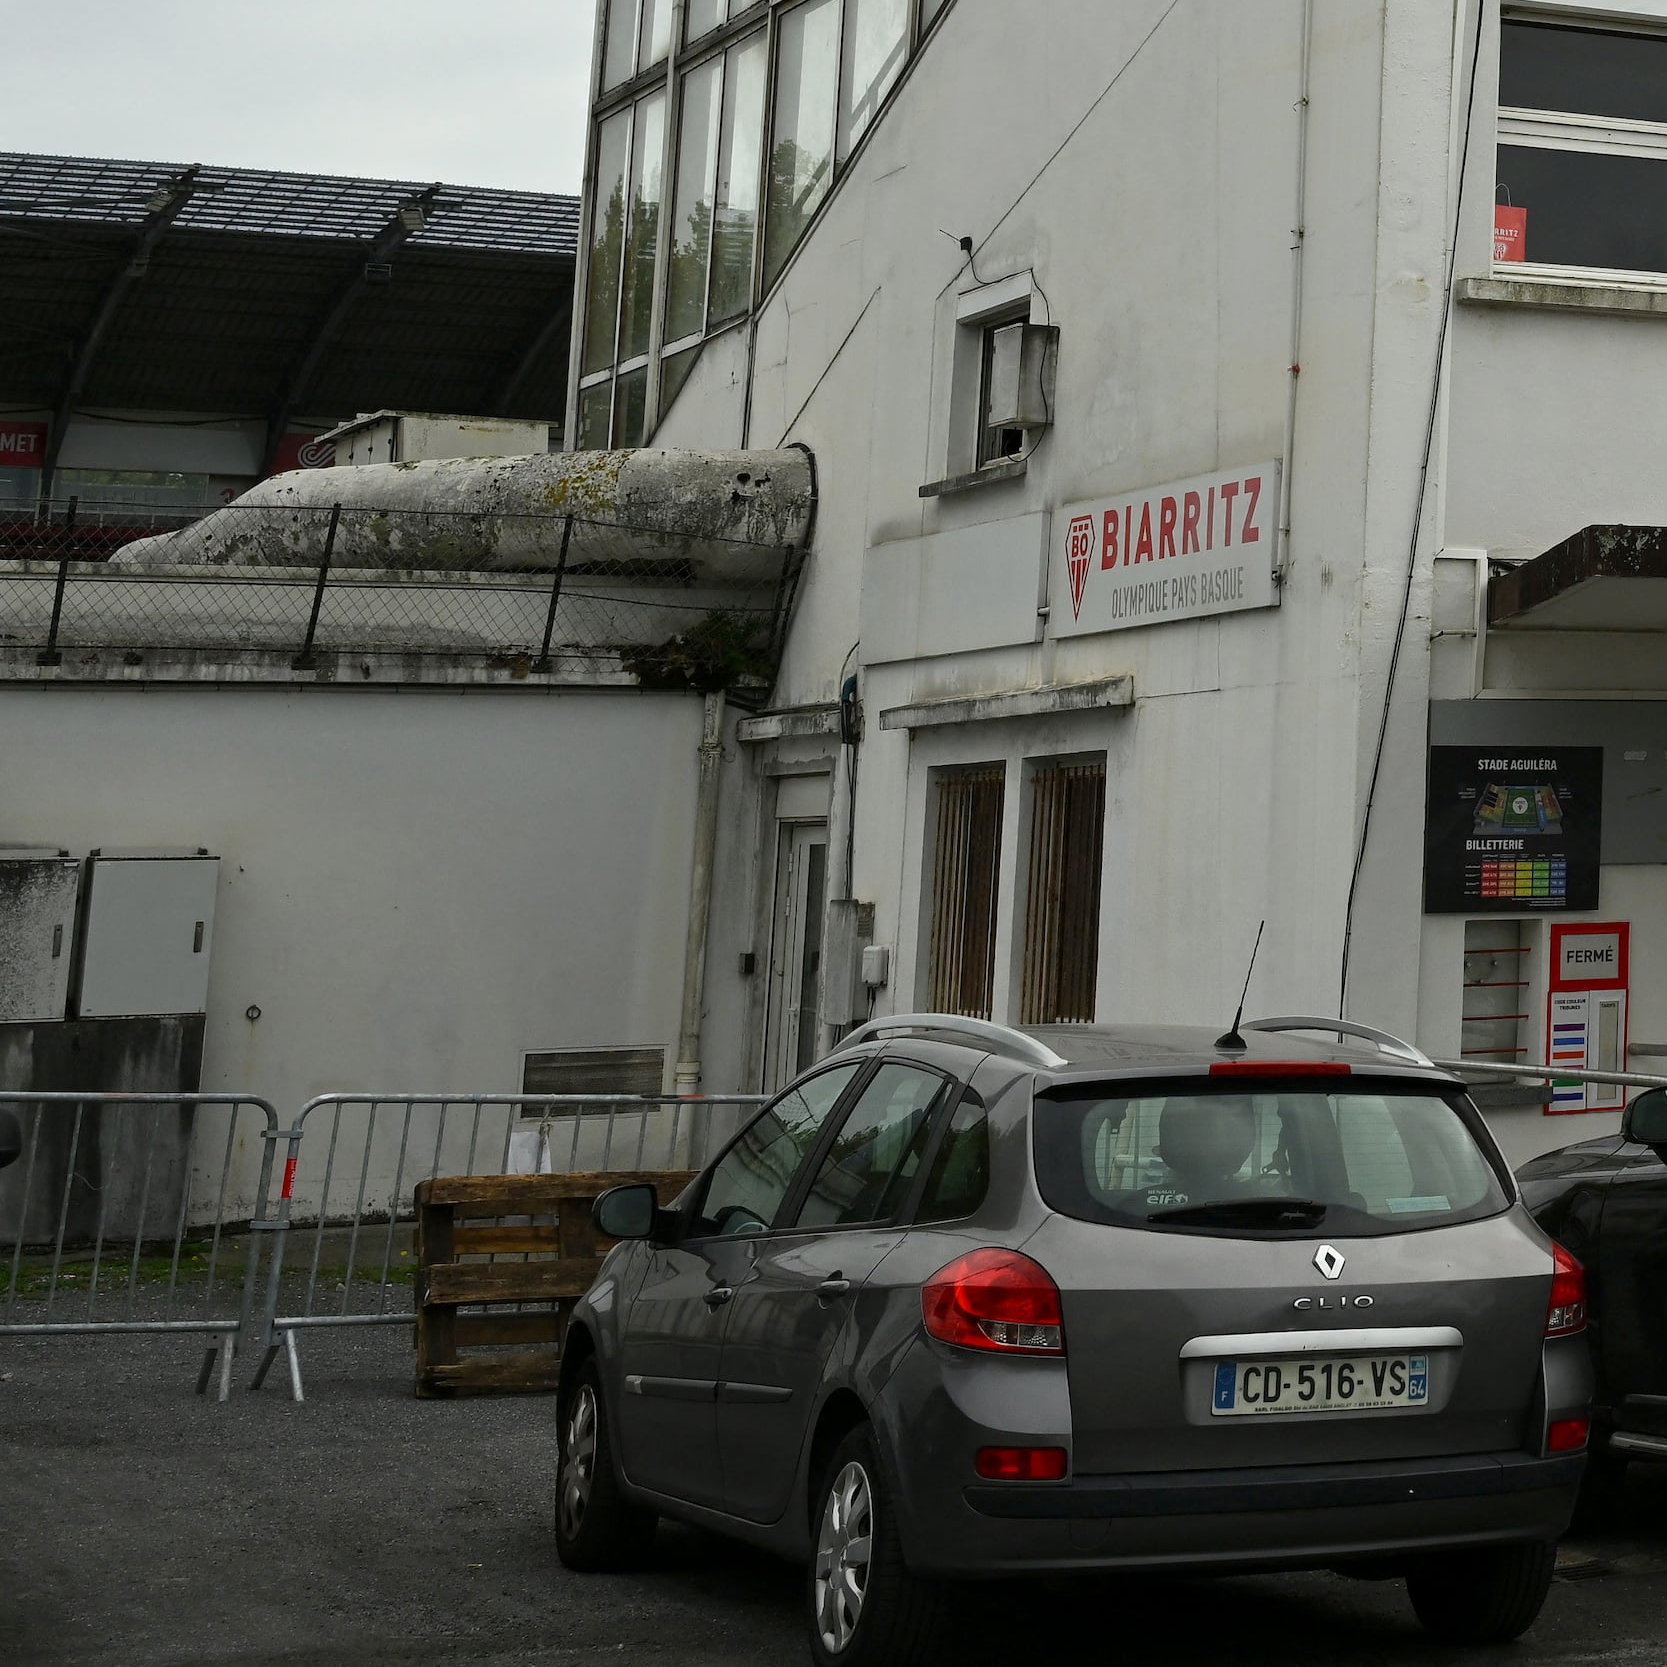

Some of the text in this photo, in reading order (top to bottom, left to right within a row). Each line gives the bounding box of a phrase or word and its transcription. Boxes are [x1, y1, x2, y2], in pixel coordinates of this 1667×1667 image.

[1101, 476, 1262, 572] BIARRITZ
[1071, 533, 1089, 558] BO
[1111, 566, 1244, 620] OLYMPIQUE PAYS BASQUE
[1478, 757, 1558, 771] STADE AGUILÉRA
[1465, 839, 1525, 851] BILLETTERIE
[1566, 945, 1614, 964] FERMÉ
[1293, 1295, 1375, 1310] CLIO
[1221, 1360, 1425, 1403] F CD-516-VS 64
